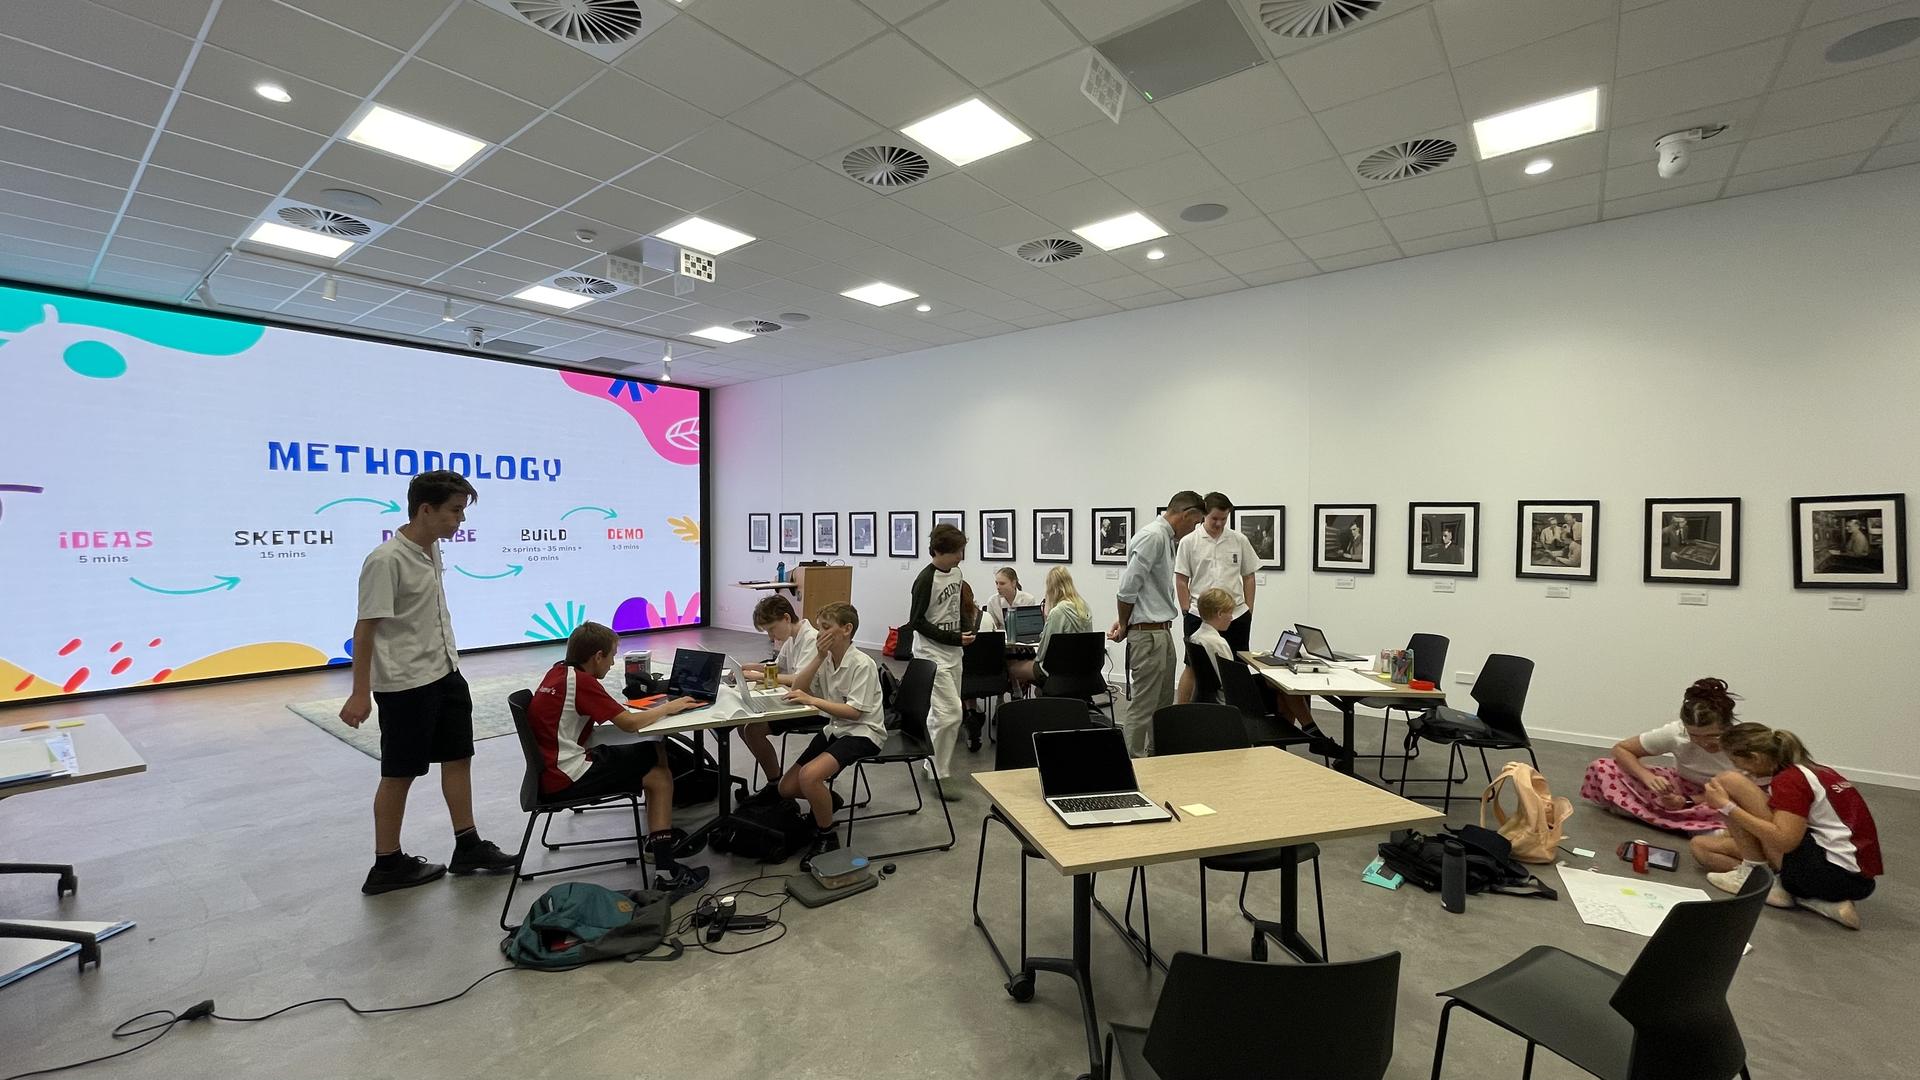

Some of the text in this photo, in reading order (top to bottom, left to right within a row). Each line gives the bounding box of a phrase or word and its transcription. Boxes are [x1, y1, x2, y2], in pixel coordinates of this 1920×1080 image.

[268, 441, 561, 482] METHODOLOGY
[234, 530, 334, 546] SKETCH
[607, 528, 644, 540] DEMO
[260, 550, 307, 559] 15 mins
[513, 546, 541, 554] sprints
[79, 554, 129, 564] 5 mins
[540, 554, 560, 562] mins
